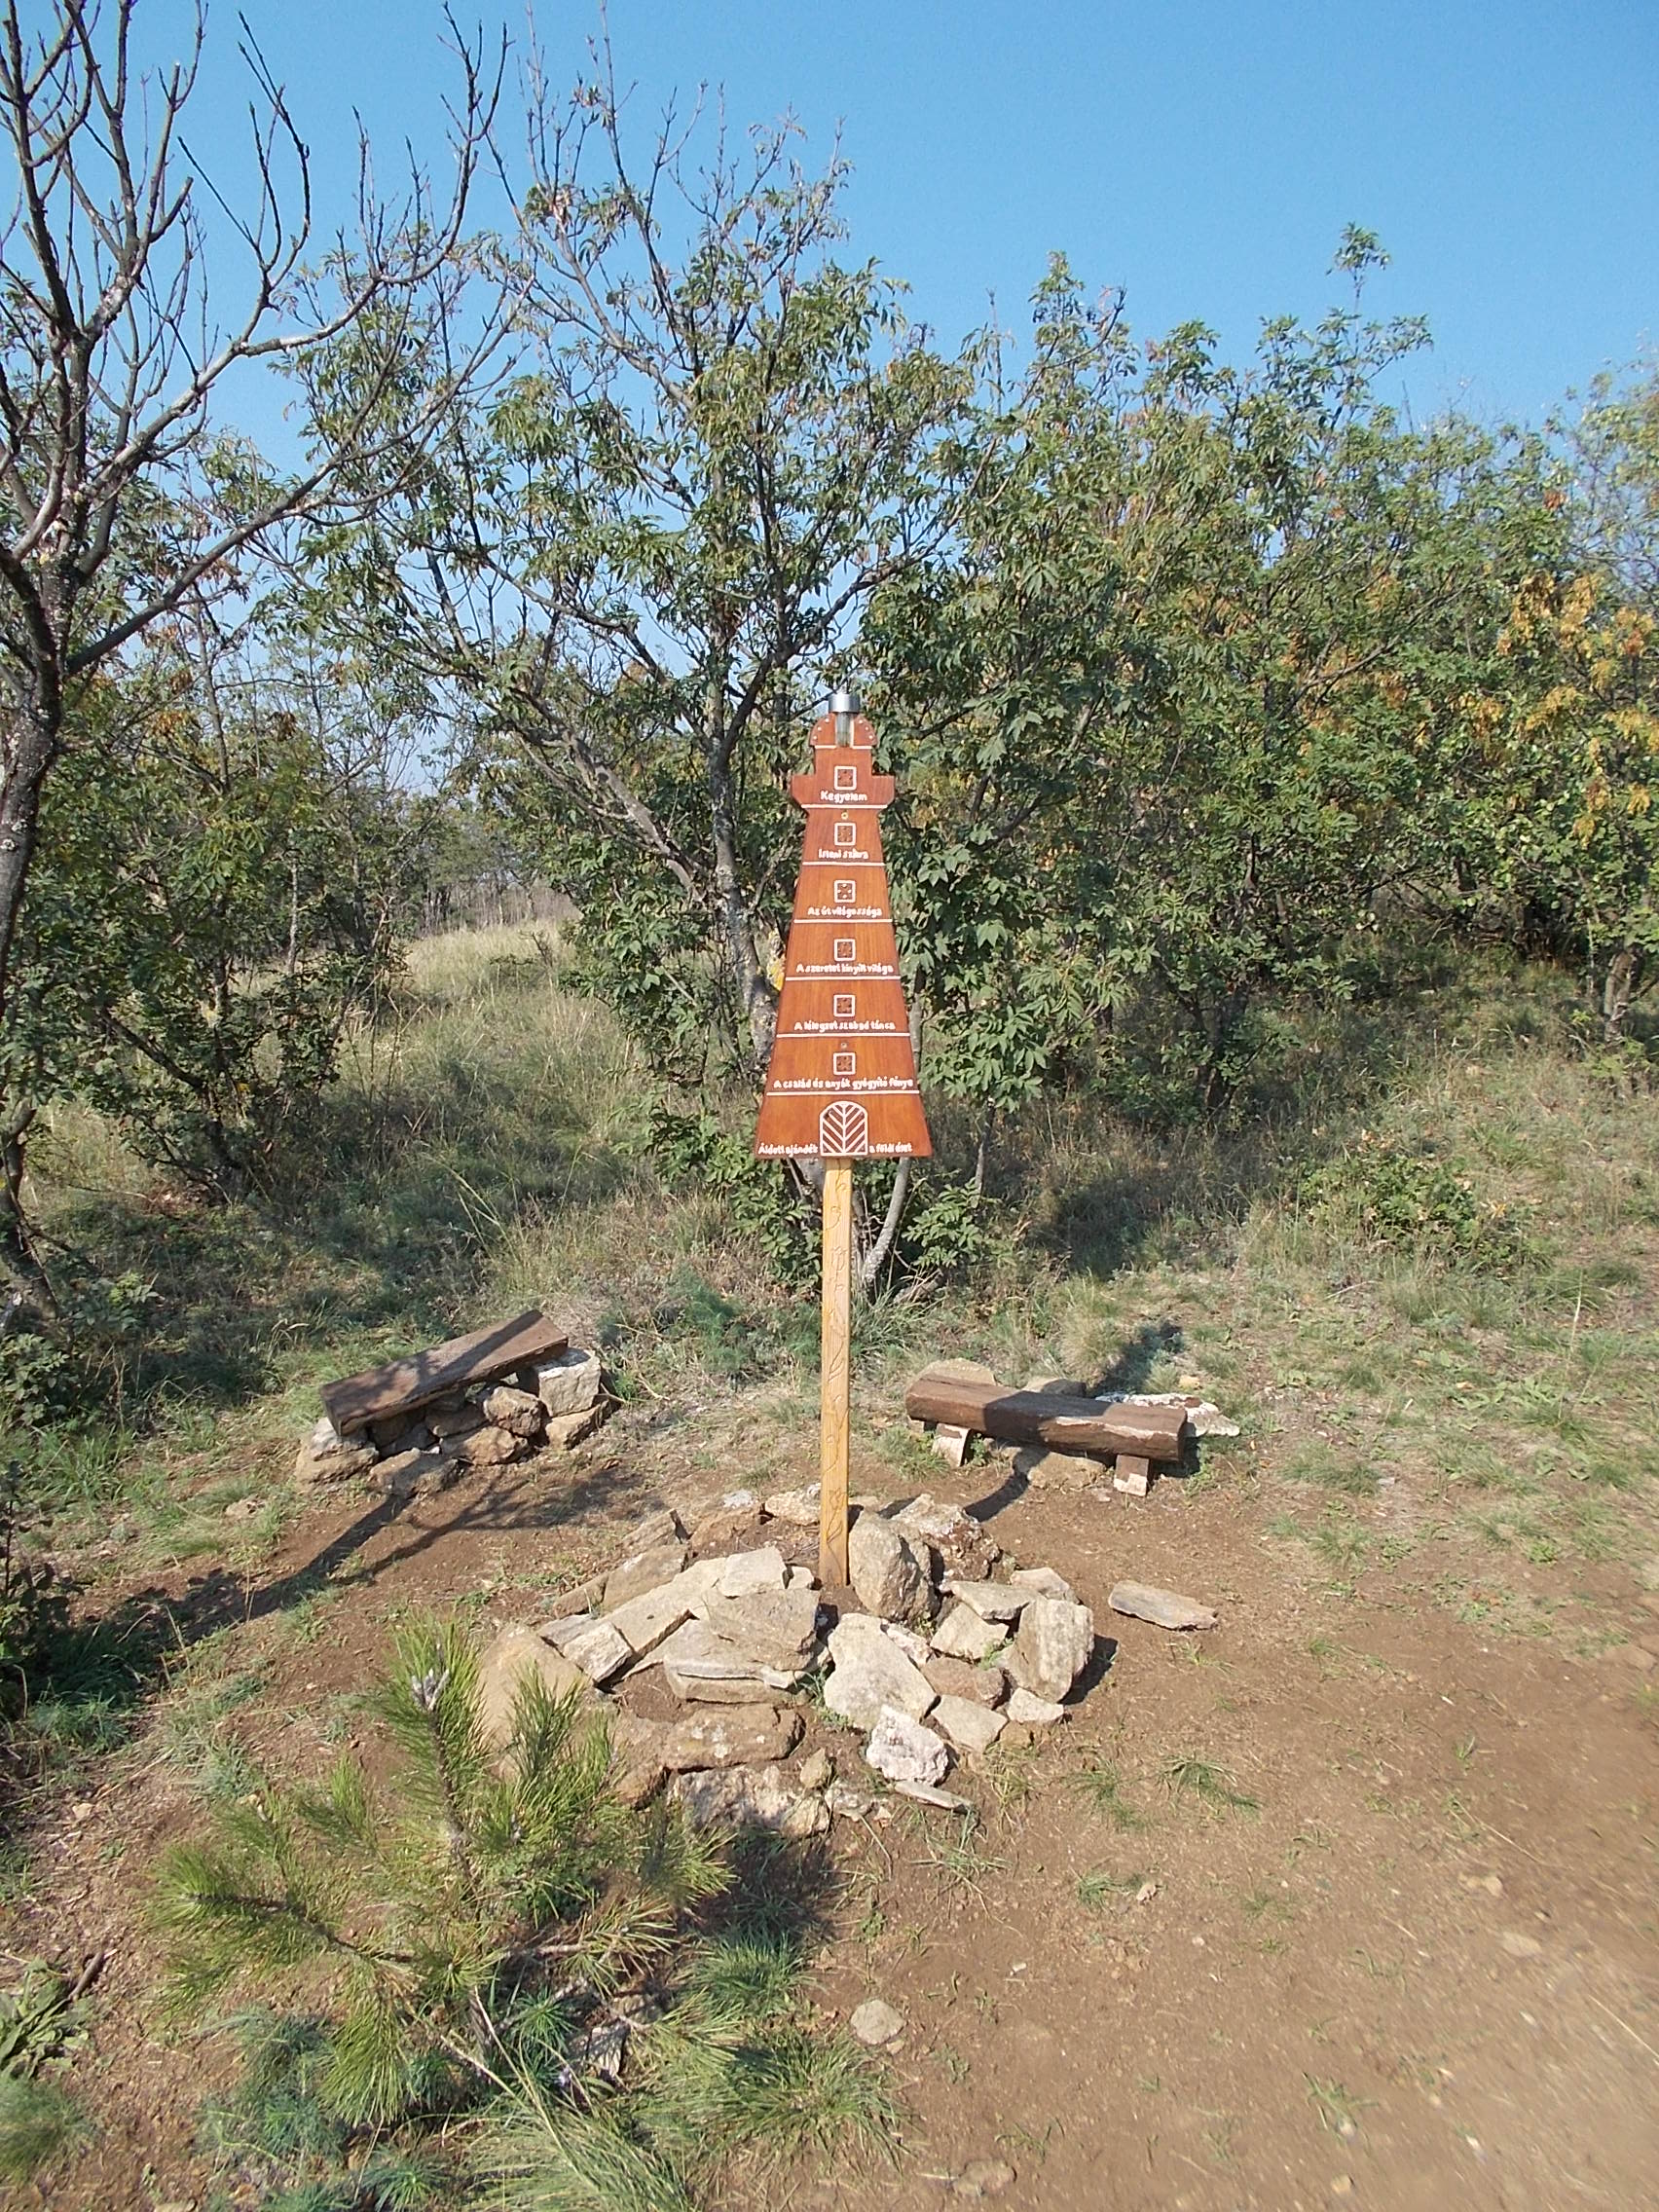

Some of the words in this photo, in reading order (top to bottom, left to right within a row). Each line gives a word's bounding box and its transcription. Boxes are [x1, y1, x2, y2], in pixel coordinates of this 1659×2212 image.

[820, 791, 867, 803] Kegyelem
[807, 906, 820, 916] Az
[831, 905, 882, 918] világossága
[795, 963, 804, 973] A
[793, 1021, 803, 1031] A
[838, 1020, 869, 1031] szabad
[869, 1019, 896, 1030] tánca
[773, 1080, 782, 1088] A
[783, 1078, 811, 1088] család
[812, 1077, 824, 1088] és
[888, 1075, 913, 1089] fénye
[868, 1145, 875, 1154] a
